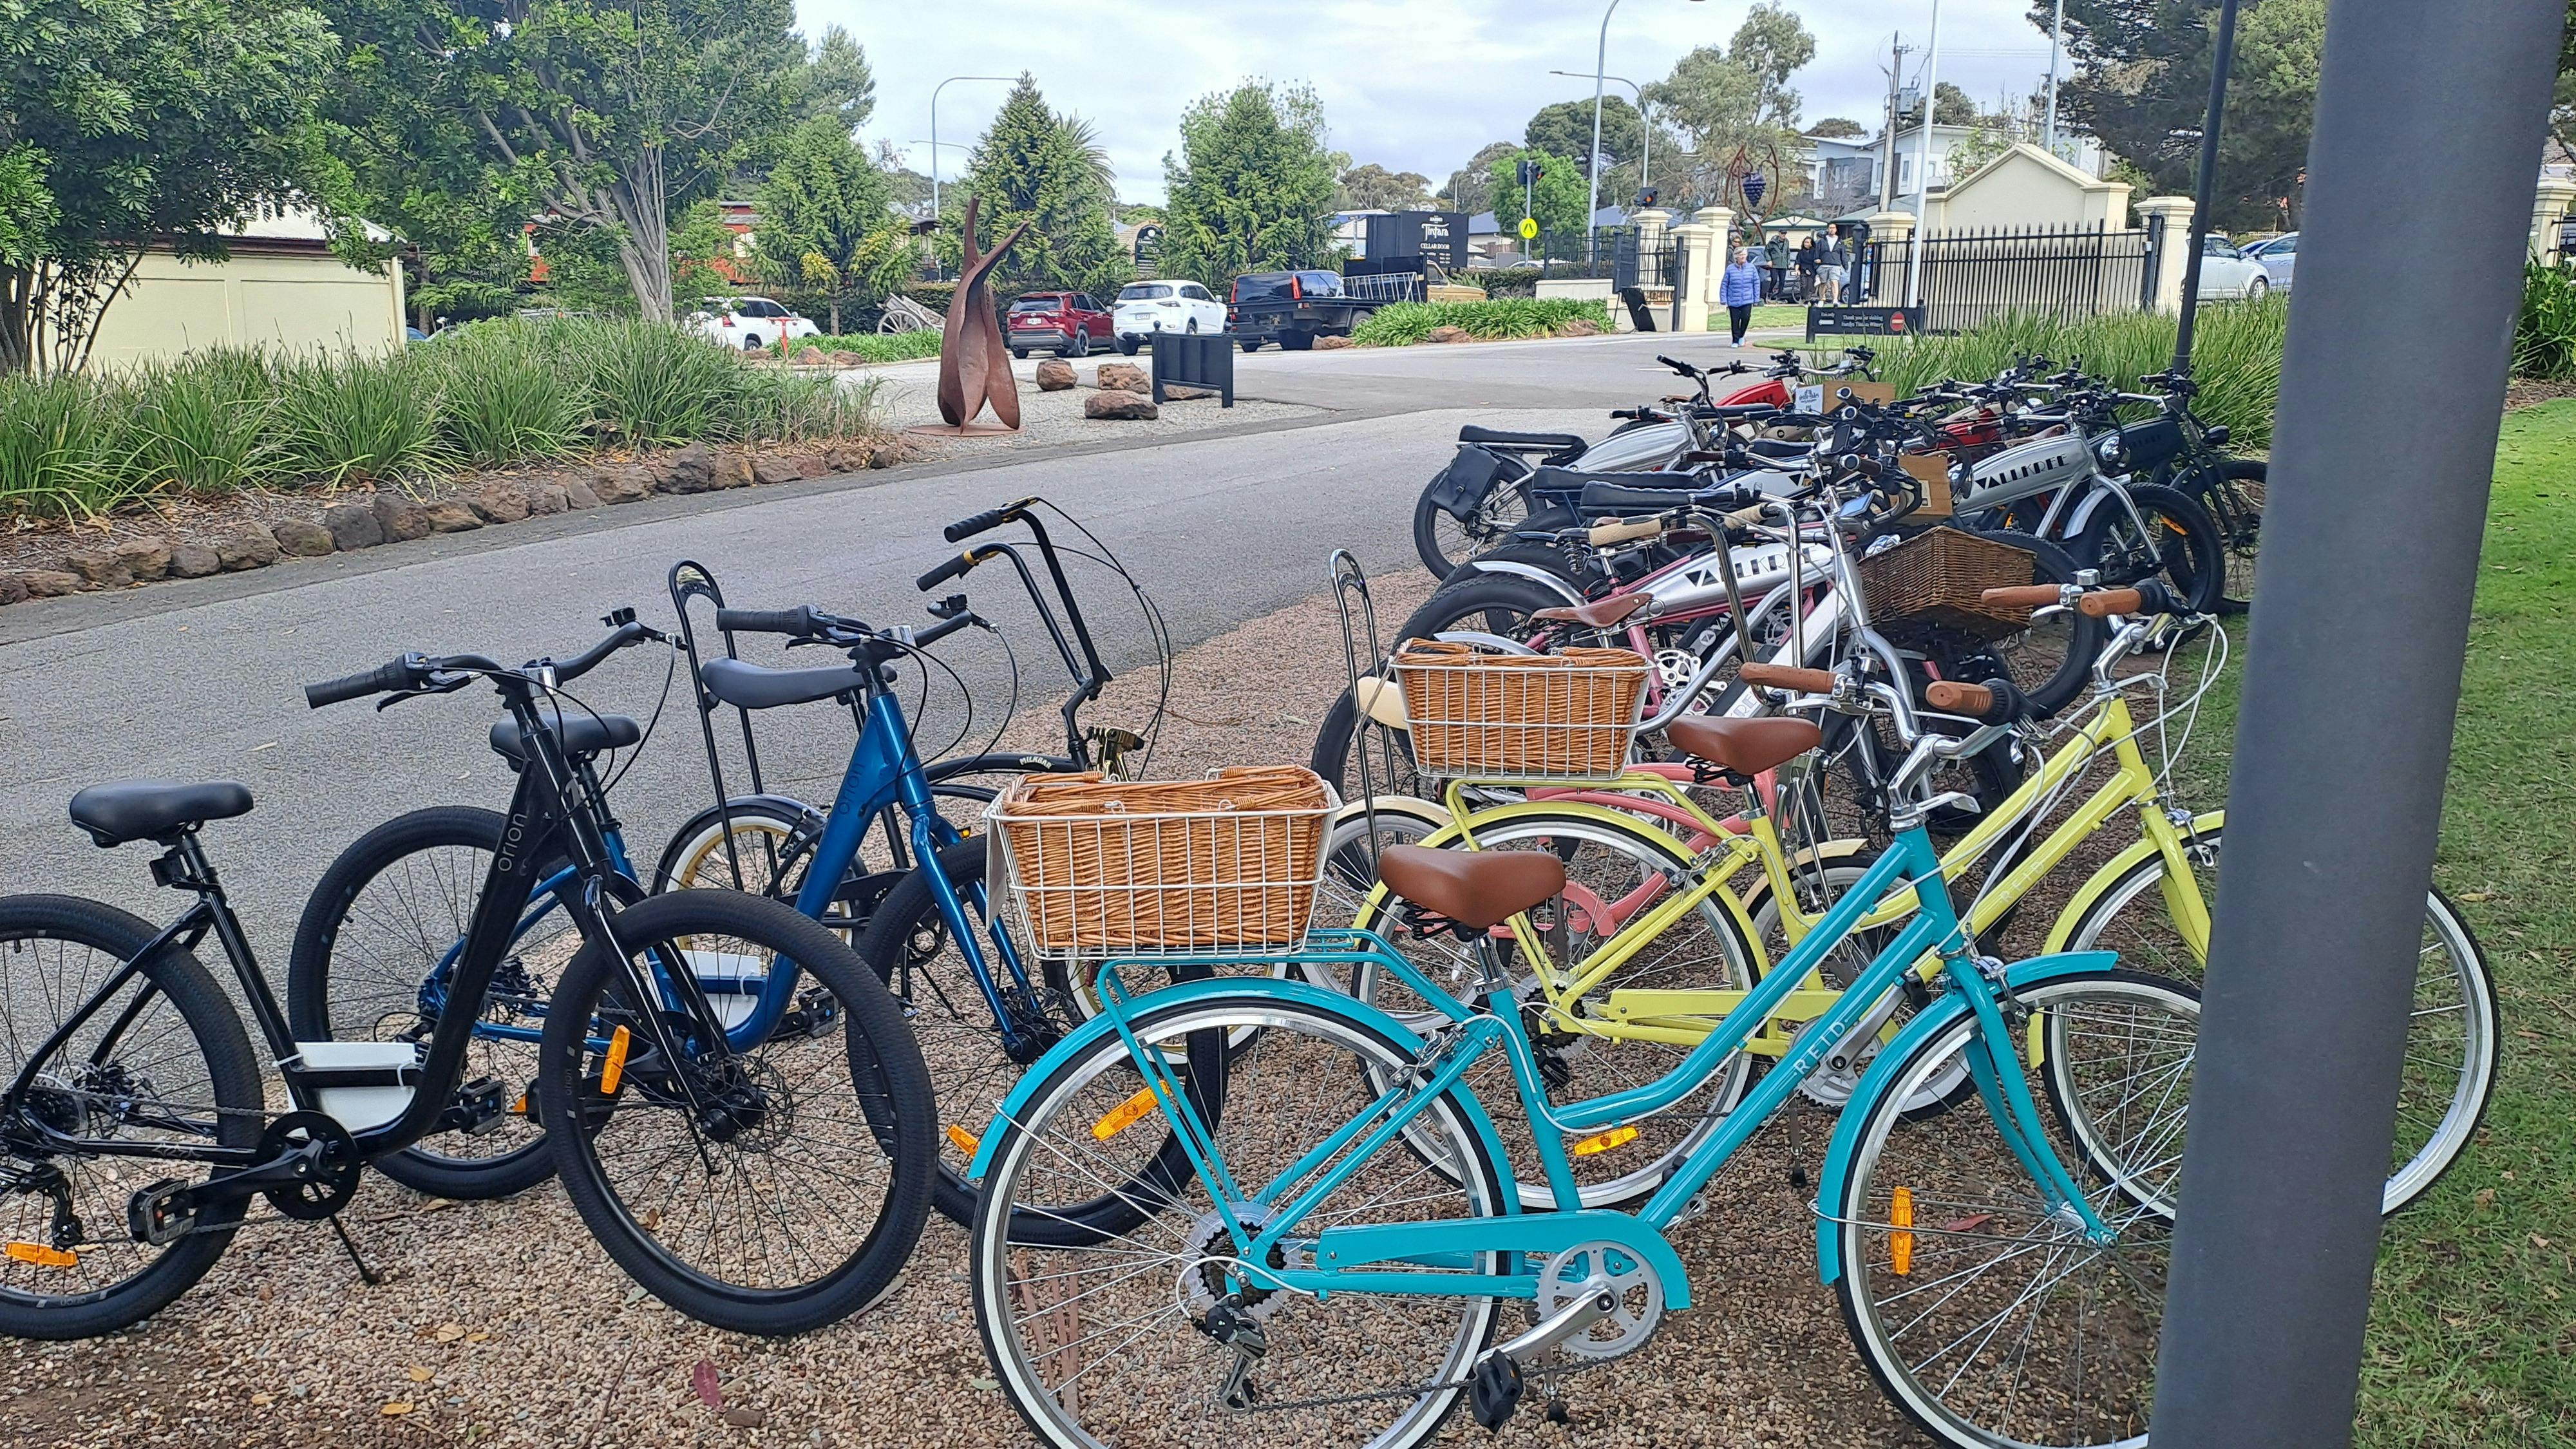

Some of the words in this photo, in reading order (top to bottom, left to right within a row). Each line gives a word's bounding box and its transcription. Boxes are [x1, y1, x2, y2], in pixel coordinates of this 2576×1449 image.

[1421, 223, 1450, 242] Tintara
[1975, 453, 2069, 490] VALLKREE
[1019, 756, 1052, 770] MILKBAR
[498, 812, 528, 872] orion
[2001, 861, 2045, 903] REID
[1793, 1021, 1847, 1075] REID
